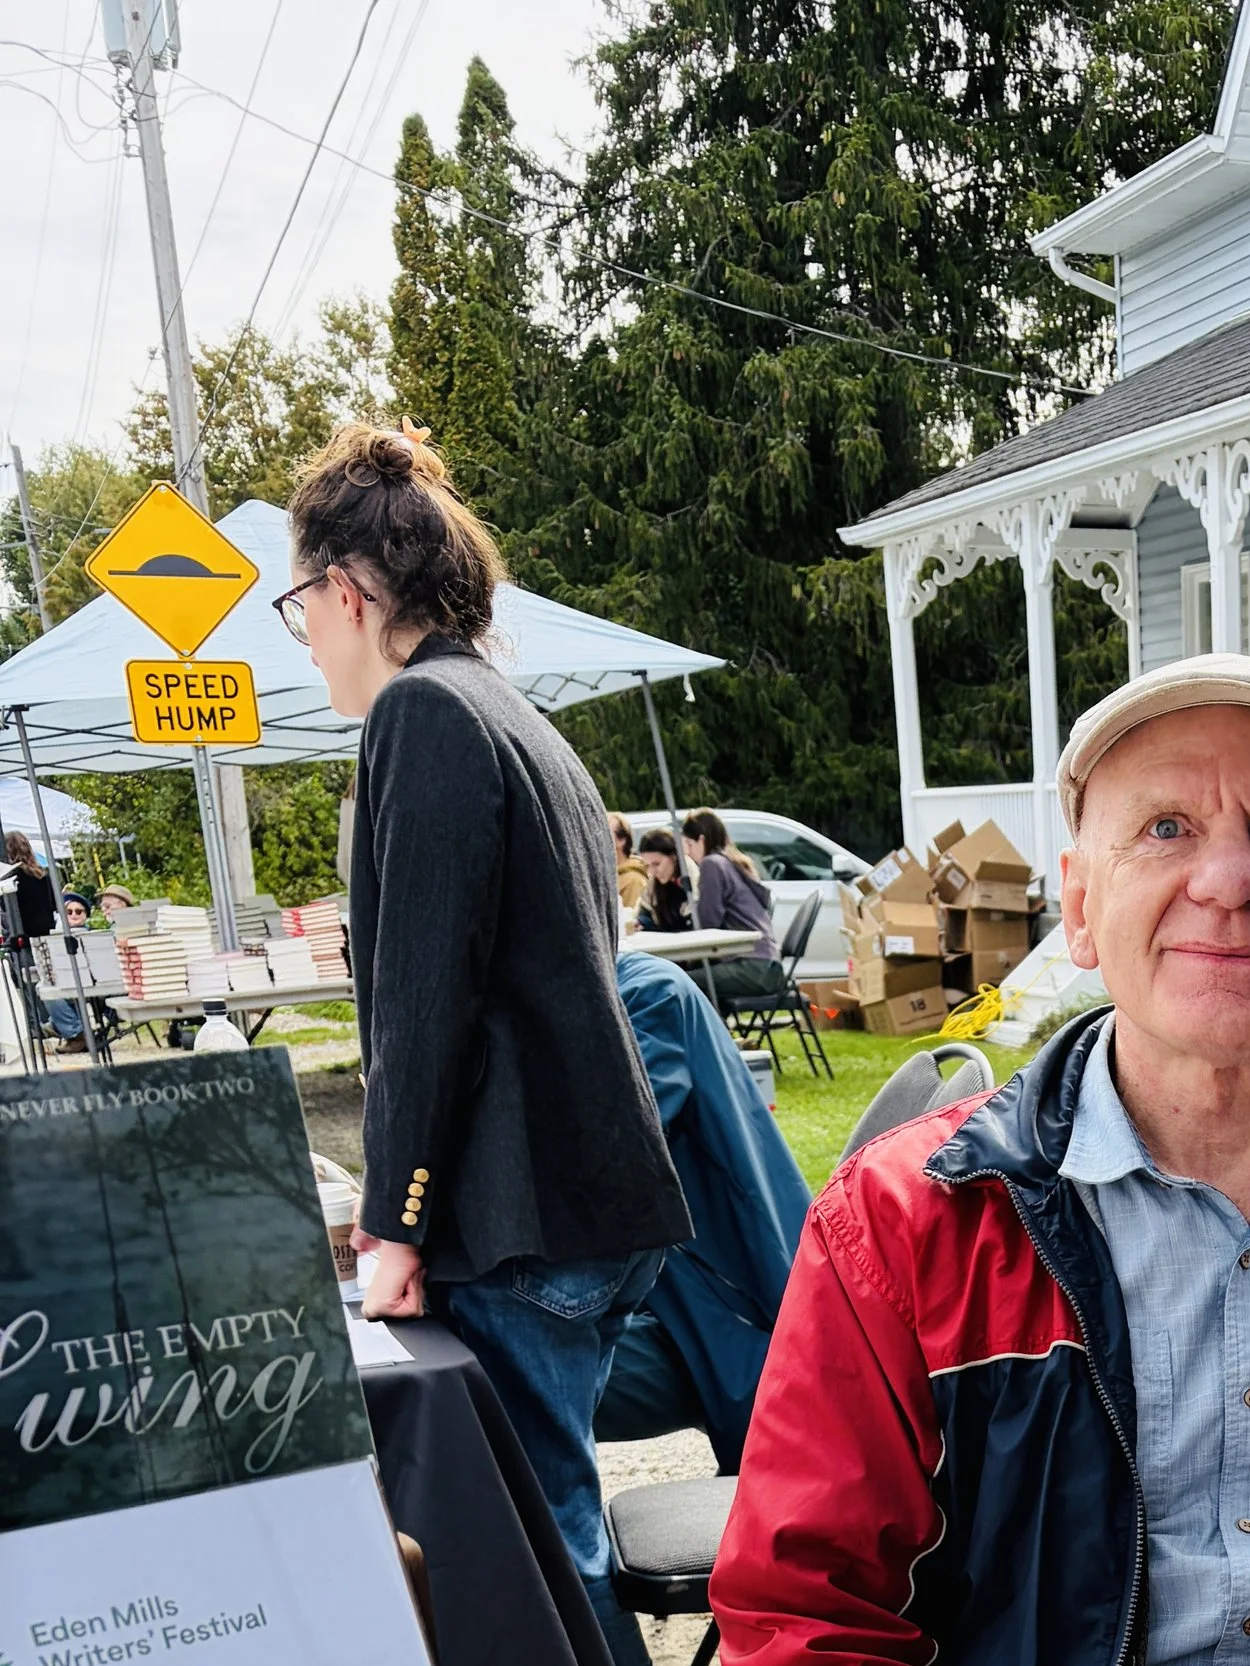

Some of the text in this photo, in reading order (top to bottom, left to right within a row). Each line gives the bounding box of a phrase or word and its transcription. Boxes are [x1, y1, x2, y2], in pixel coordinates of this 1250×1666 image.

[145, 673, 239, 700] SPEED
[154, 706, 237, 732] HUMP
[0, 1077, 255, 1122] NEVER FLY BOOK TWO
[52, 1305, 306, 1375] THE EMPTY
[30, 1596, 180, 1648] Eden Mills
[162, 1603, 268, 1650] Festival
